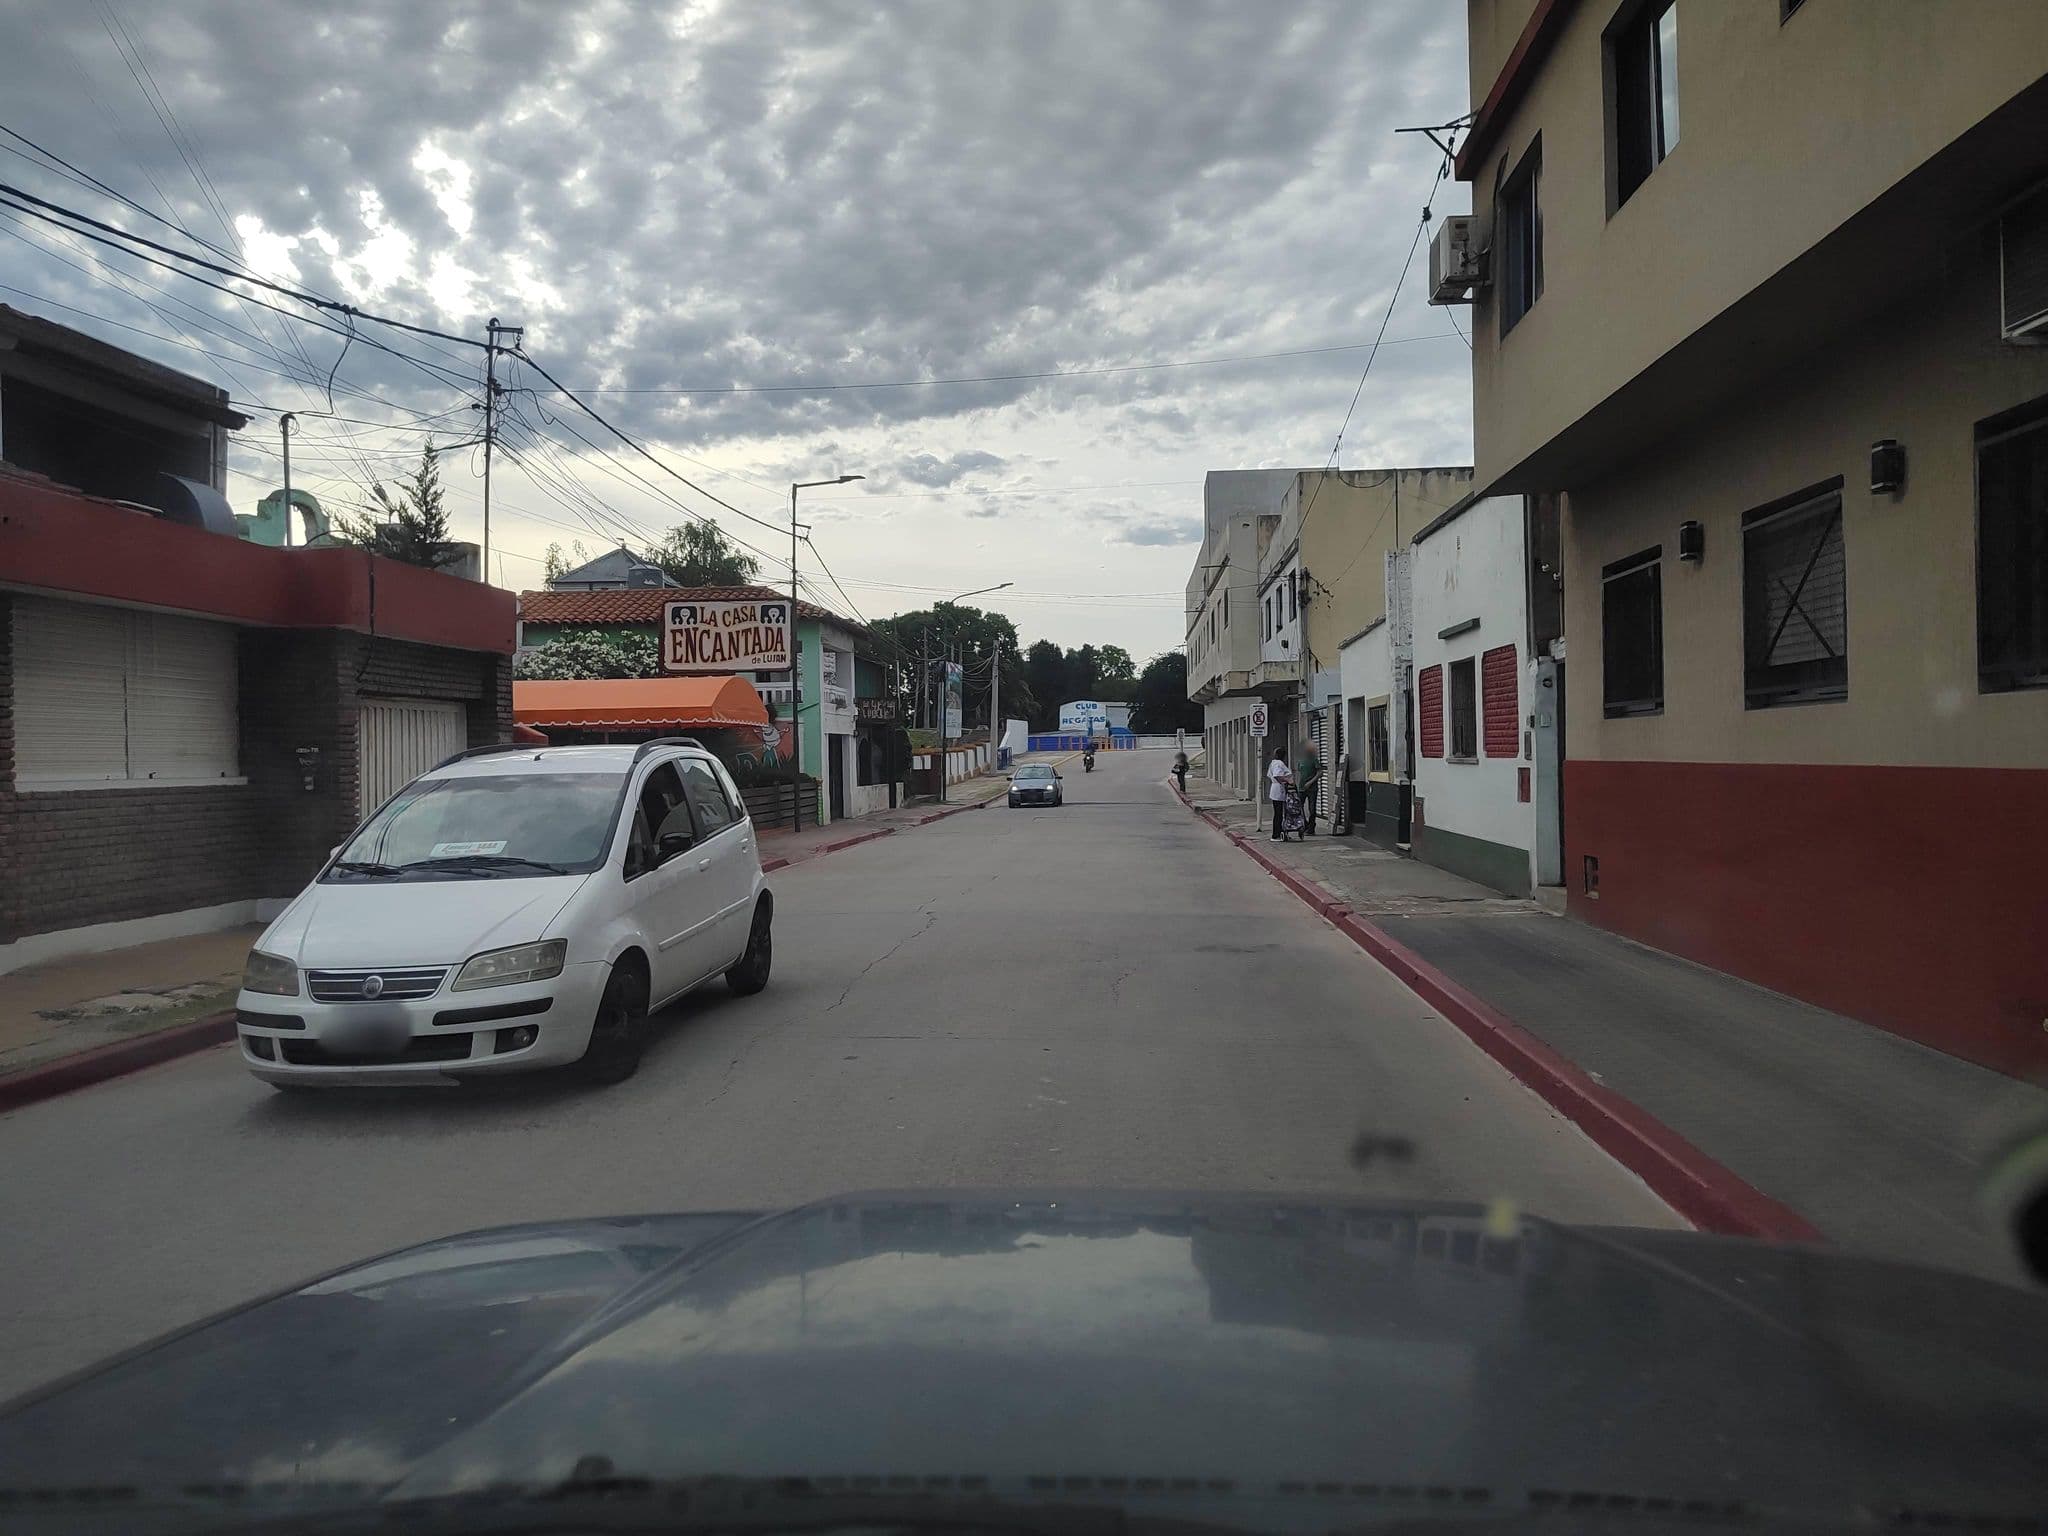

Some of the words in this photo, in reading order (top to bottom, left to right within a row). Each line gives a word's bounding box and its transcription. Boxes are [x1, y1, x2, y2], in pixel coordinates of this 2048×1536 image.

[699, 606, 718, 627] LA
[722, 605, 757, 627] CASA
[670, 626, 785, 664] ENCANTADA
[751, 656, 761, 664] de
[763, 654, 786, 664] LUJAN
[1062, 716, 1105, 724] REGATAS
